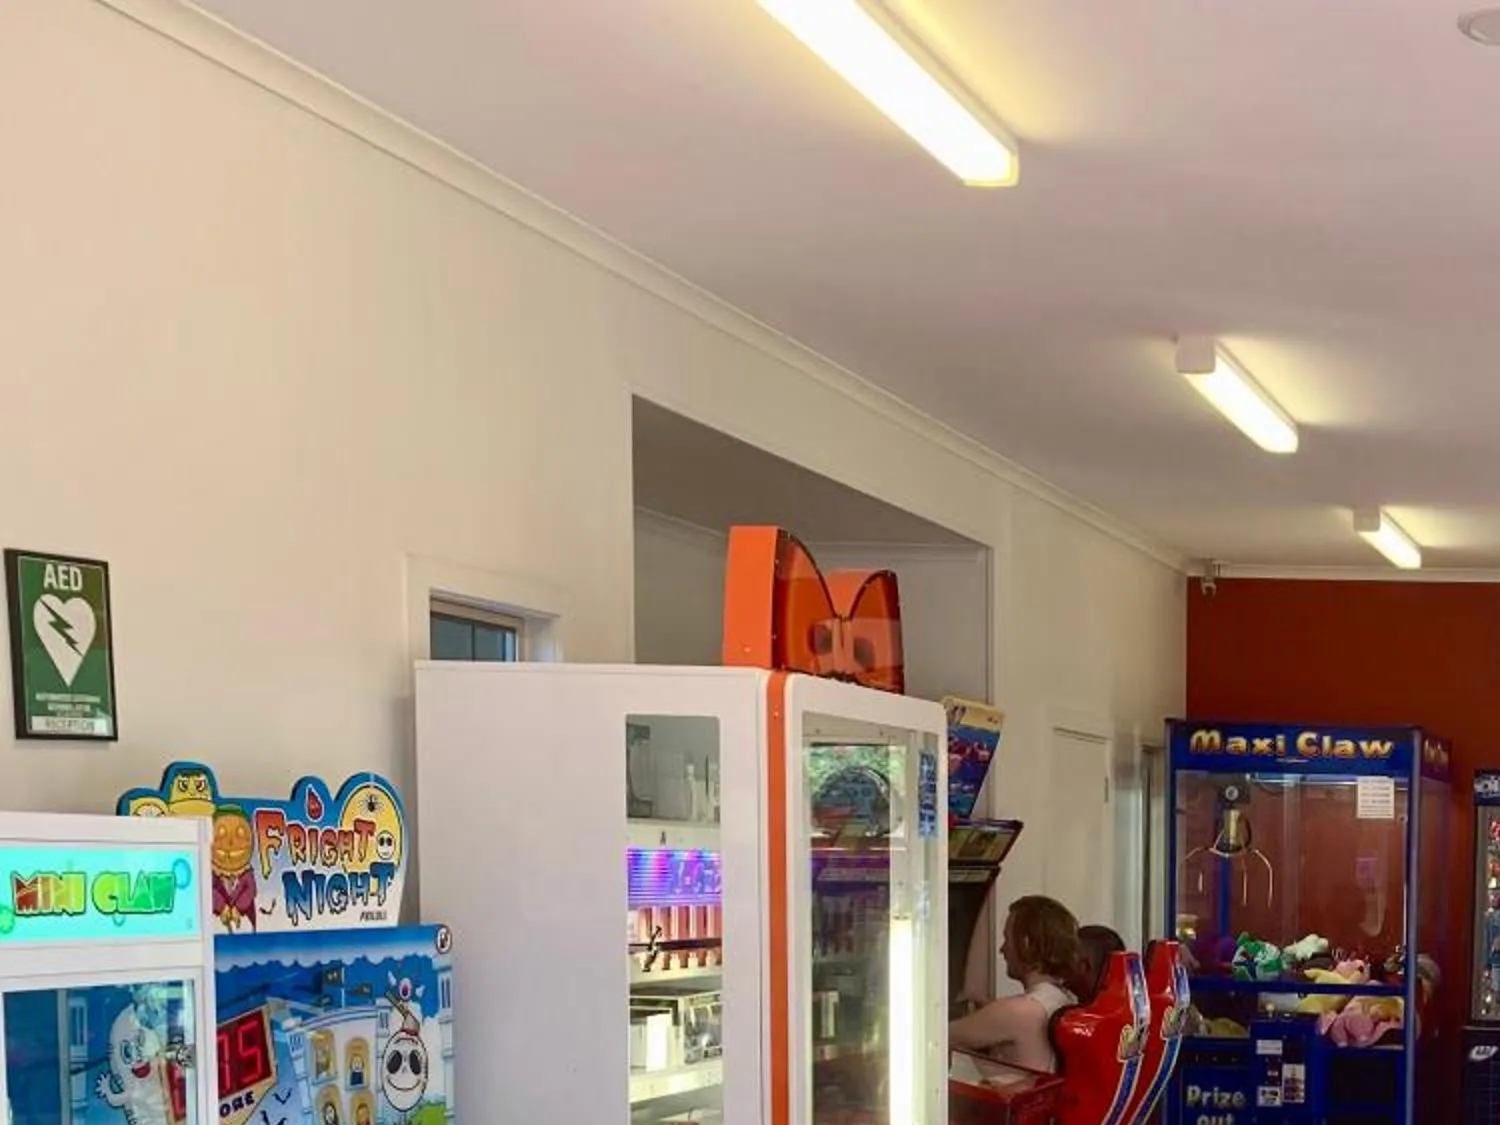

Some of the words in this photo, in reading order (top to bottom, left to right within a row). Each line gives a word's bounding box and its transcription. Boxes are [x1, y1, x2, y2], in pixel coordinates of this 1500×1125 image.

[43, 563, 84, 591] AED
[1190, 729, 1286, 756] Maxi
[1296, 731, 1395, 759] Claw
[255, 809, 377, 880] FRIGHT
[10, 870, 87, 917] MINI
[91, 870, 177, 915] CLAW
[282, 862, 395, 927] NIGHT
[220, 1091, 255, 1118] ORE
[1186, 1085, 1246, 1109] Prize
